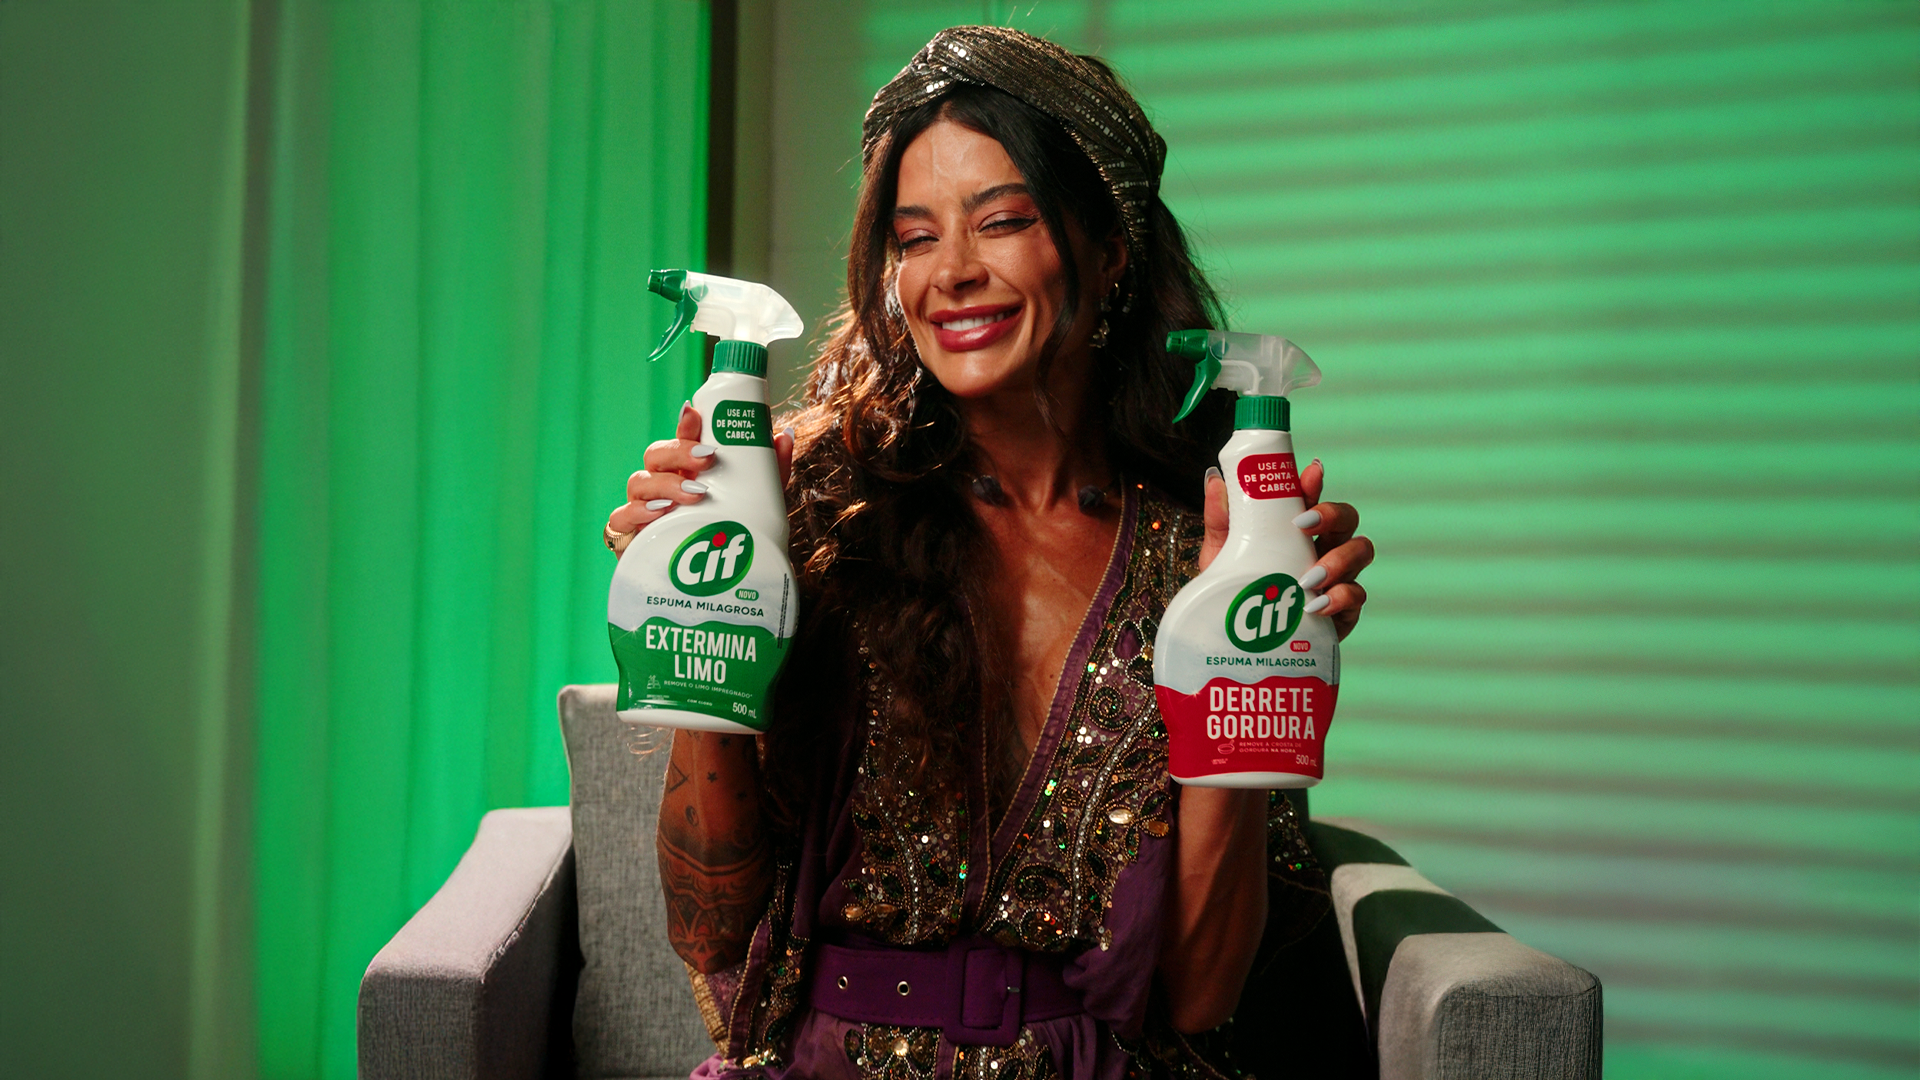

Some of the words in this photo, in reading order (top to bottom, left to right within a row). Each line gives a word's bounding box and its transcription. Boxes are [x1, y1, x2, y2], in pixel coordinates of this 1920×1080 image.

[727, 409, 740, 417] USE
[742, 408, 755, 418] ATÉ
[716, 419, 726, 428] DE
[727, 420, 755, 428] PONTA-
[726, 431, 755, 441] CABEÇA
[1258, 462, 1277, 471] USE
[1244, 474, 1257, 483] DE
[1260, 472, 1295, 481] PONTA-
[1259, 483, 1296, 492] CABEÇA
[676, 531, 746, 586] Cif
[738, 590, 756, 600] NOVO
[647, 596, 692, 609] ESPUMA
[696, 602, 764, 617] MILAGROSA
[1234, 584, 1297, 642] Cif
[646, 625, 757, 662] EXTERMINA
[1293, 642, 1309, 651] NOVO
[1206, 656, 1252, 666] ESPUMA
[1256, 658, 1317, 667] MILAGROSA
[674, 654, 727, 684] LIMO
[1210, 686, 1314, 713] DERRETE
[732, 702, 747, 715] 500
[1207, 714, 1315, 740] GORDURA
[1296, 754, 1309, 765] 500
